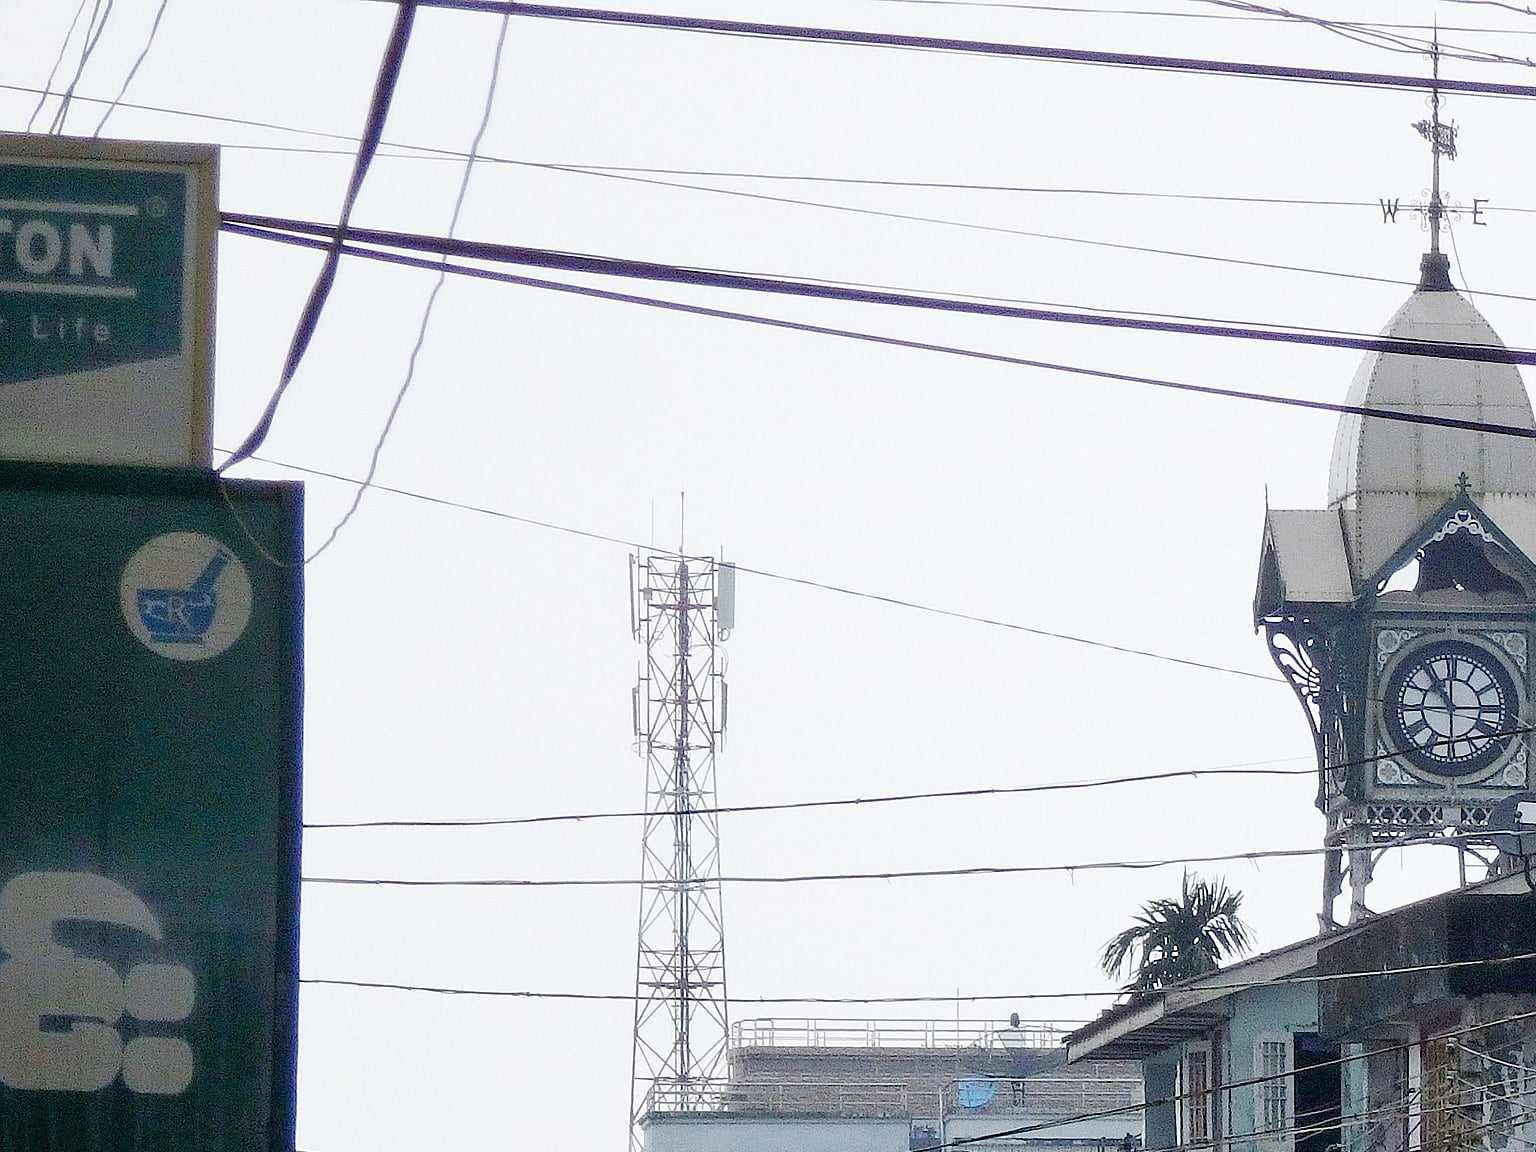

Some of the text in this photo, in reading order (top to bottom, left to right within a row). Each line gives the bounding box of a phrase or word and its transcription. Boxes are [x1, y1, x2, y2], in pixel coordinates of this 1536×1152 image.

[1379, 198, 1490, 226] W E
[0, 217, 114, 278] ON
